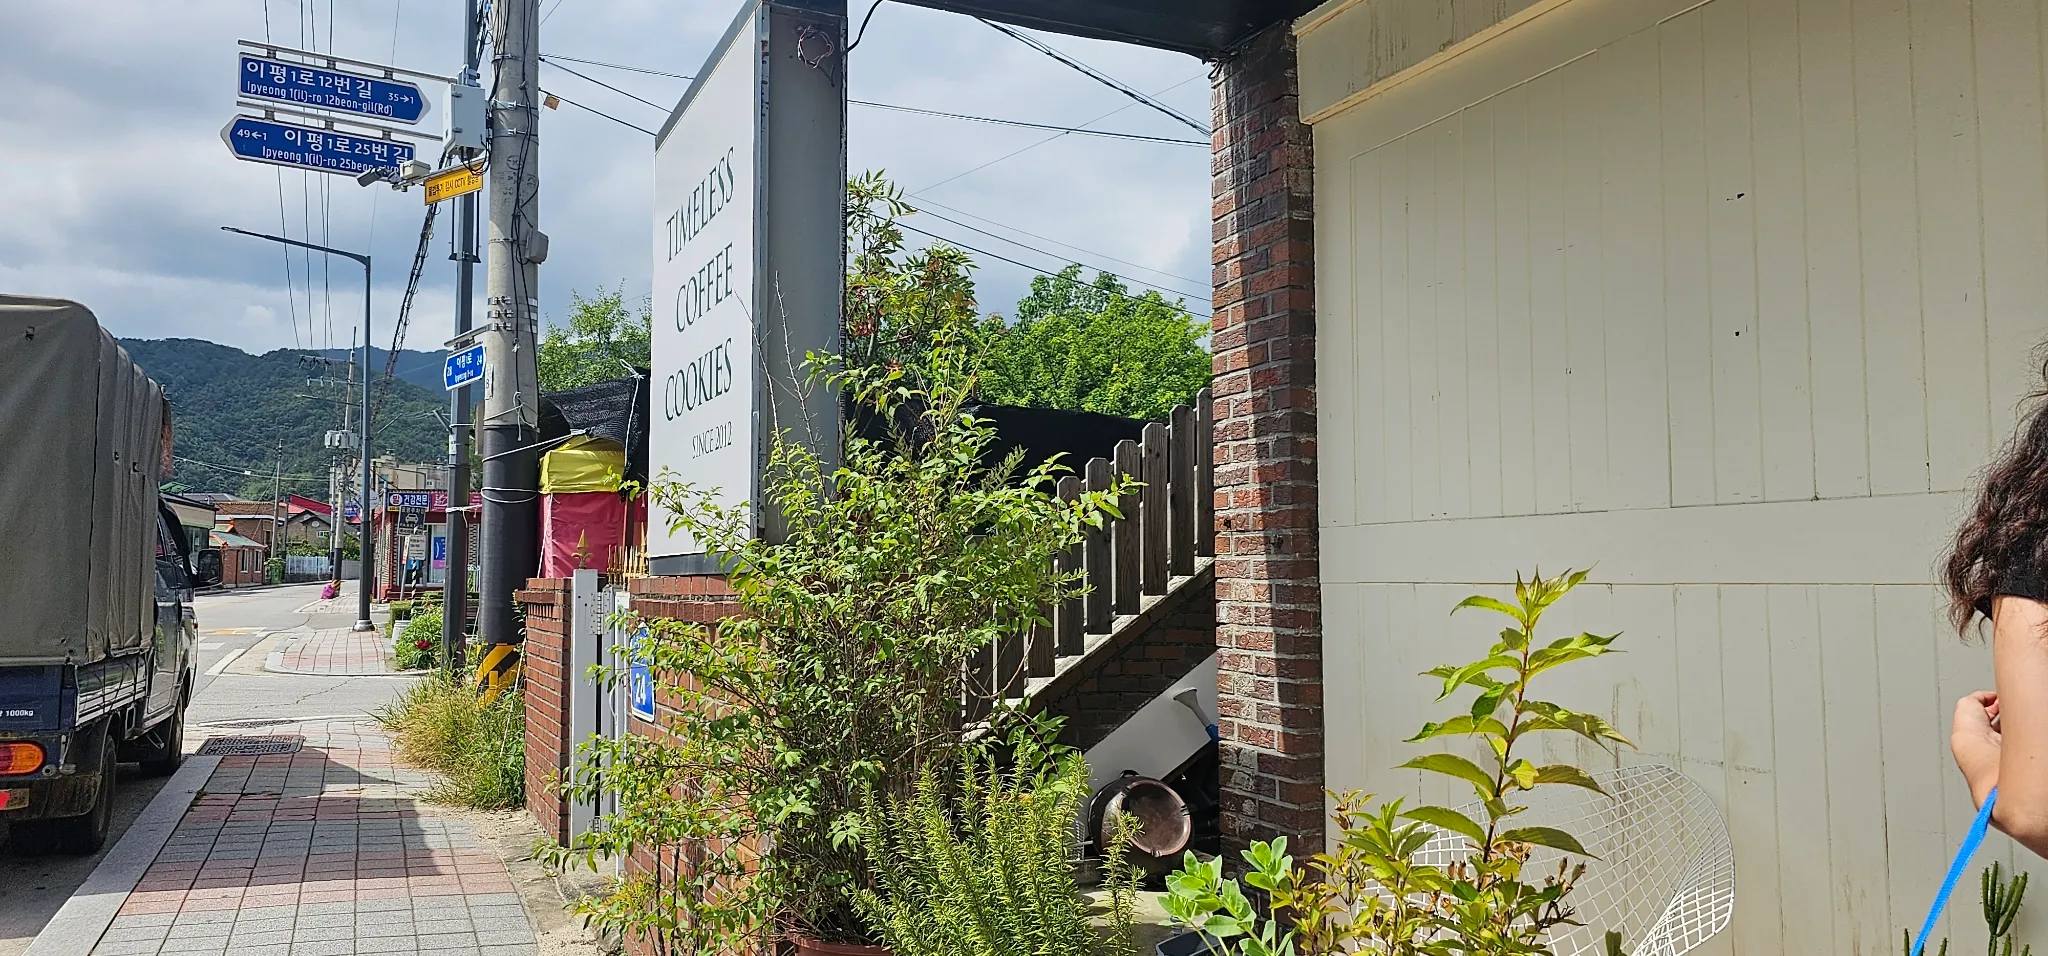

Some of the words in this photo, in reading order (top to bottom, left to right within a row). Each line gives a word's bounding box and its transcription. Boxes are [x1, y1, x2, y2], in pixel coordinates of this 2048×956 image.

[247, 80, 287, 99] Ipyeong
[289, 88, 322, 103] 1(il)-ro
[324, 94, 393, 117] 12beon-gil(Rd)
[388, 92, 399, 102] 35
[237, 128, 251, 139] 49
[262, 145, 301, 164] Ipyeong
[304, 152, 337, 167] 1(il)-ro
[666, 146, 734, 263] TIMELESS
[675, 242, 733, 333] COFFEE
[665, 337, 732, 422] COOKIES
[692, 428, 714, 459] SINCE
[715, 421, 732, 451] 2012
[5, 709, 34, 717] 1000kg
